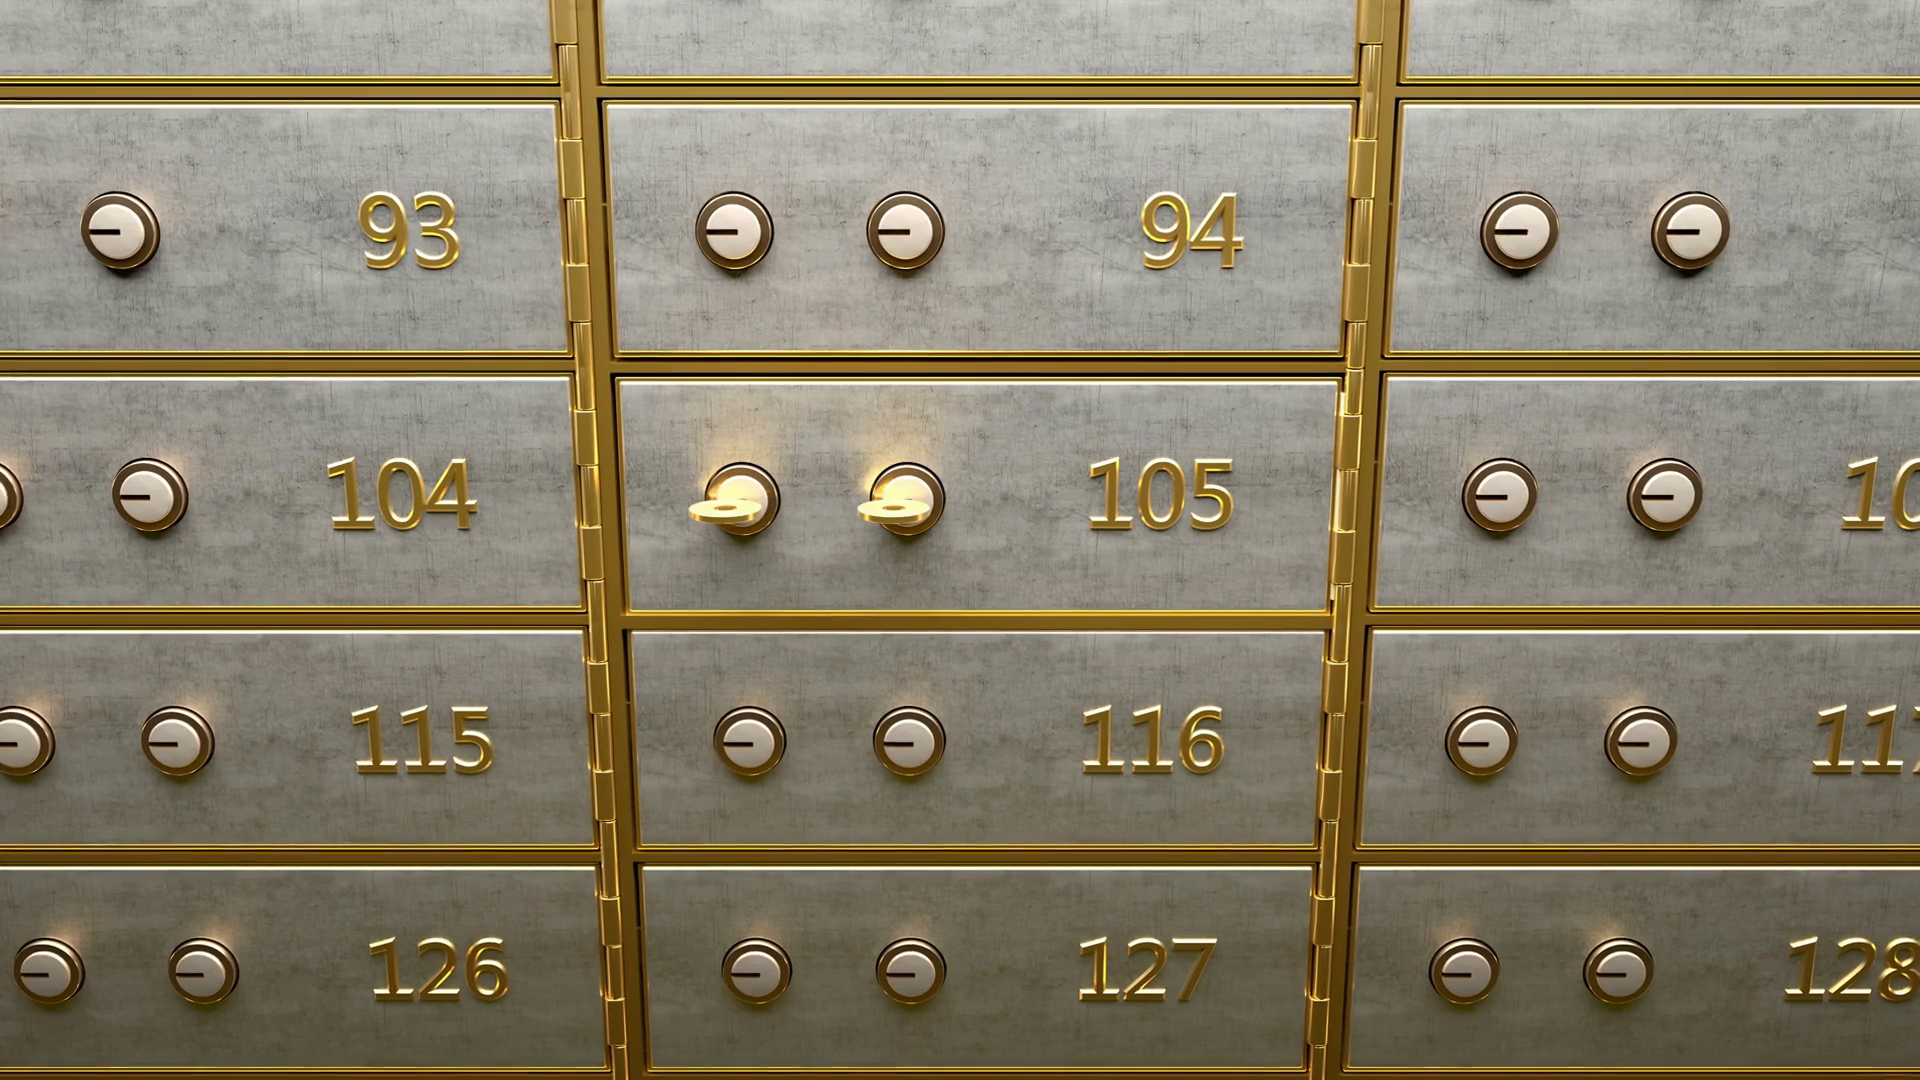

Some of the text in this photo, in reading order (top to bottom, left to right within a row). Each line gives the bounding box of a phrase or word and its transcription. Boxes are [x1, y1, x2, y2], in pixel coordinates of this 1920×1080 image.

[357, 191, 461, 269] 93
[1140, 191, 1244, 269] 94
[326, 457, 477, 530] 104
[1088, 457, 1234, 530] 105
[351, 705, 493, 774] 115
[1081, 705, 1224, 774] 116
[1812, 704, 1920, 774] 11
[369, 937, 508, 1001] 126
[1078, 937, 1218, 1002] 127
[1784, 936, 1920, 1001] 128
